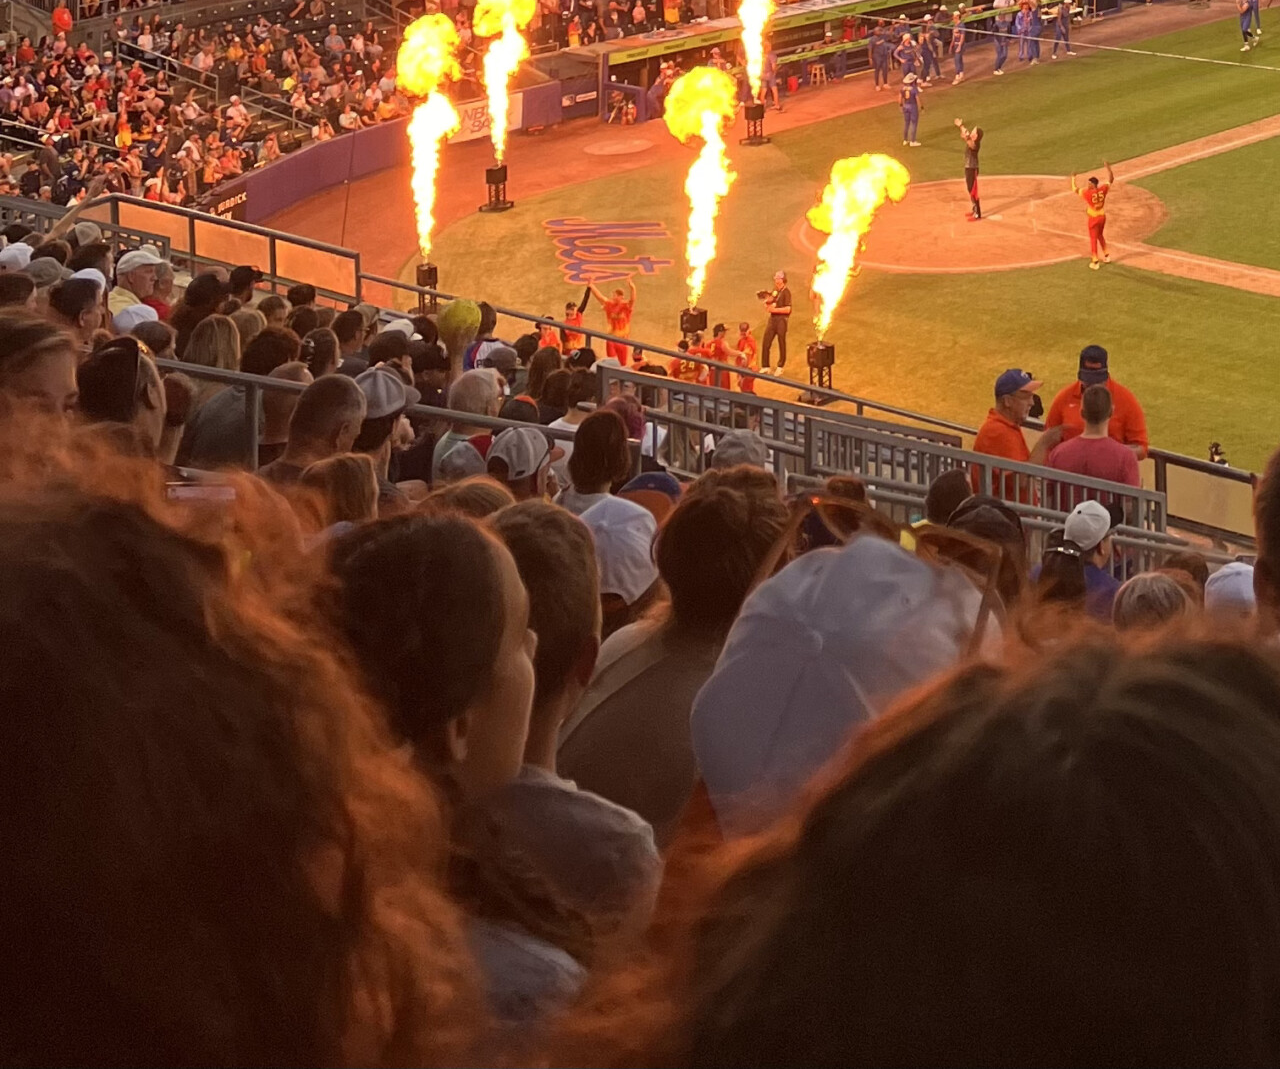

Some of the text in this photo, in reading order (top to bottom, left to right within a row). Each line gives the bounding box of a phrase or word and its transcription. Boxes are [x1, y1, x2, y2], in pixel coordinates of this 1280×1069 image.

[1091, 190, 1105, 204] 25
[541, 216, 675, 285] Mets
[680, 359, 696, 372] 24
